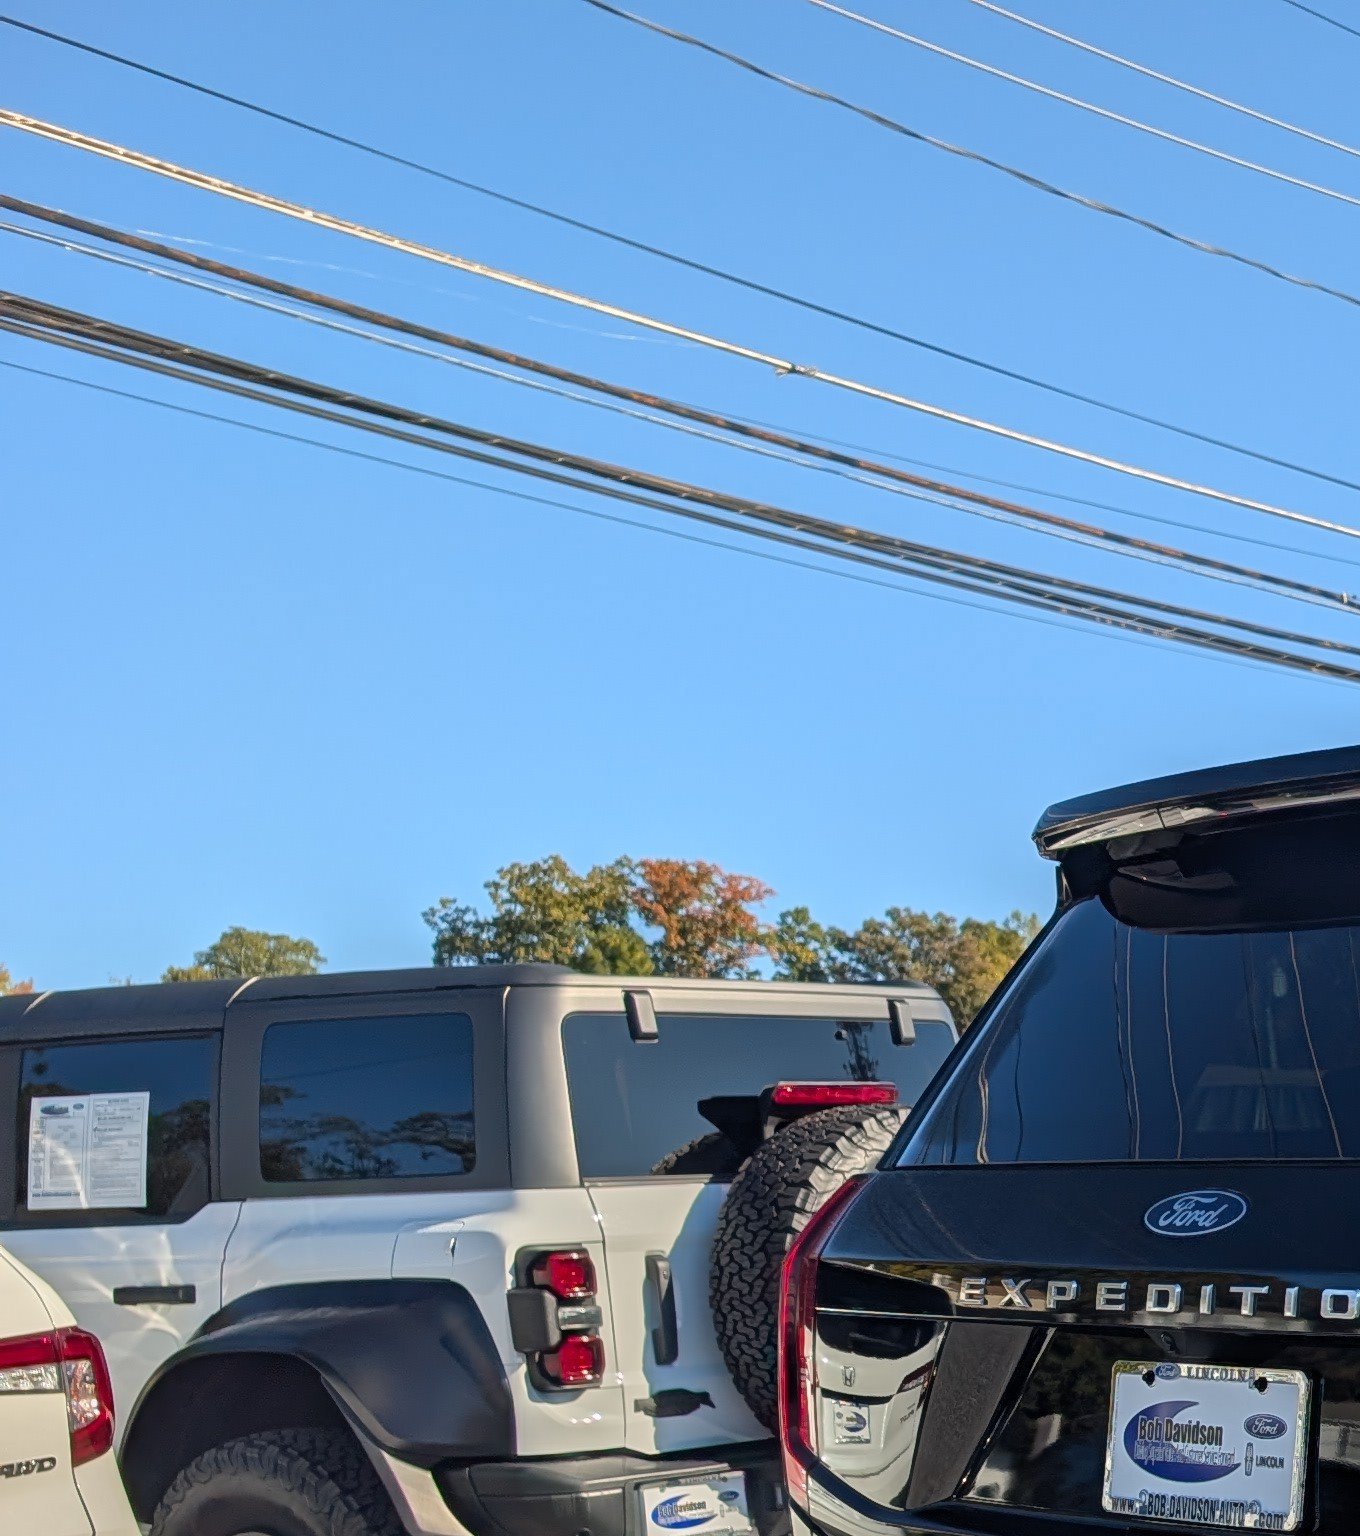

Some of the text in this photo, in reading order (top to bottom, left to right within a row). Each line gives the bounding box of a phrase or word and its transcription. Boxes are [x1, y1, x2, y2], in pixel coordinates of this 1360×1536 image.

[1155, 1194, 1226, 1231] Ford
[1187, 1366, 1248, 1382] LINCOLN
[1138, 1417, 1223, 1446] Bob Davidson
[1250, 1415, 1281, 1436] Ford
[1255, 1454, 1285, 1469] LINCOLN
